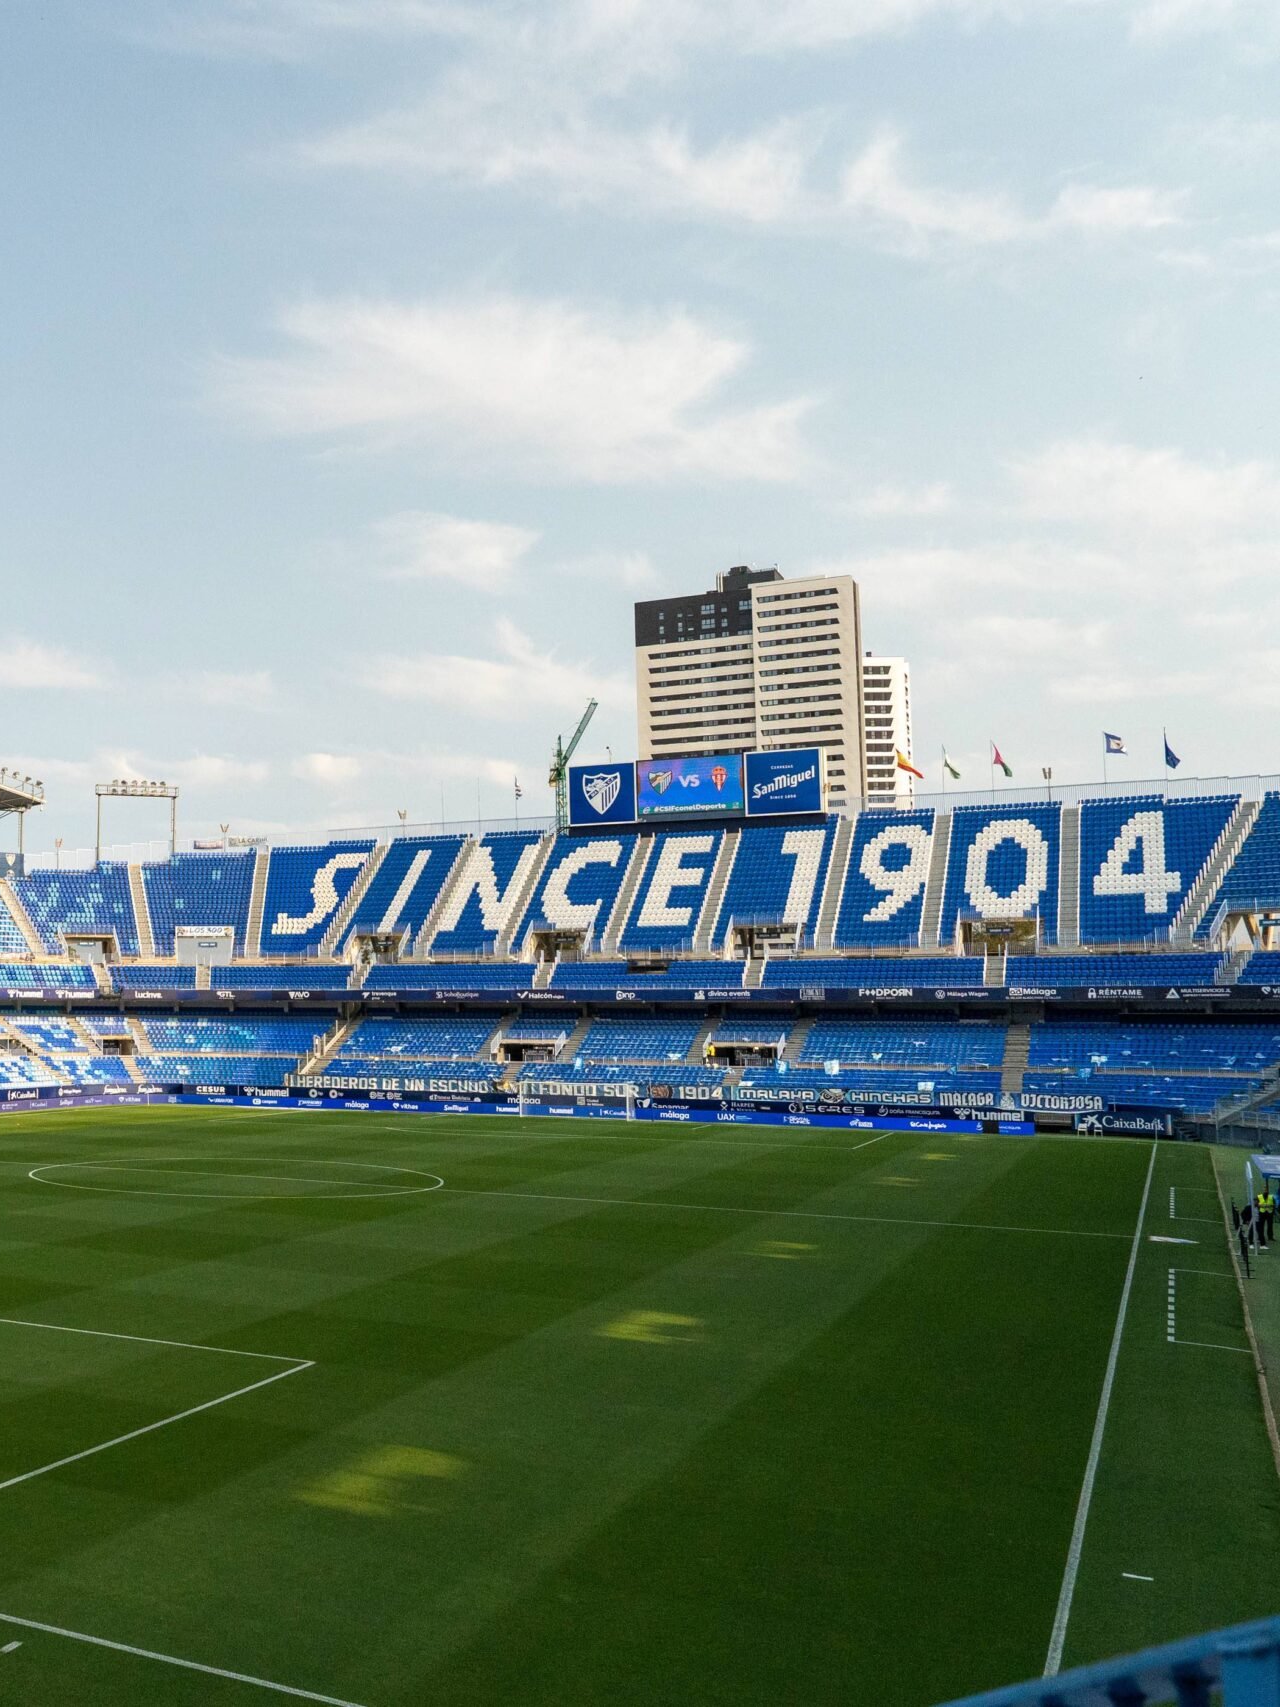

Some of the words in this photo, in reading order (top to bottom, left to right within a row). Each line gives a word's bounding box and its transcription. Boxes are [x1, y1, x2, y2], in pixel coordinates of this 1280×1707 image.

[678, 774, 700, 788] VS
[272, 836, 714, 935] SINCE
[781, 811, 1182, 924] 1904
[65, 990, 95, 999] hummel
[528, 991, 553, 999] Halcón
[1022, 988, 1057, 997] Málaga
[1098, 988, 1142, 996] RÉNTAME
[297, 1076, 377, 1090] HEREDEROS
[382, 1078, 400, 1090] DE
[404, 1079, 425, 1091] UN
[429, 1079, 489, 1093] ESCUDO
[255, 1086, 290, 1097] hummel
[539, 1083, 597, 1096] FONDO
[603, 1084, 640, 1098] SUR
[679, 1086, 723, 1100] 1904
[851, 1091, 932, 1104] HINCHAS
[717, 1113, 735, 1121] UAX
[971, 1108, 1025, 1122] hummel
[1102, 1115, 1165, 1132] CaixaBank
